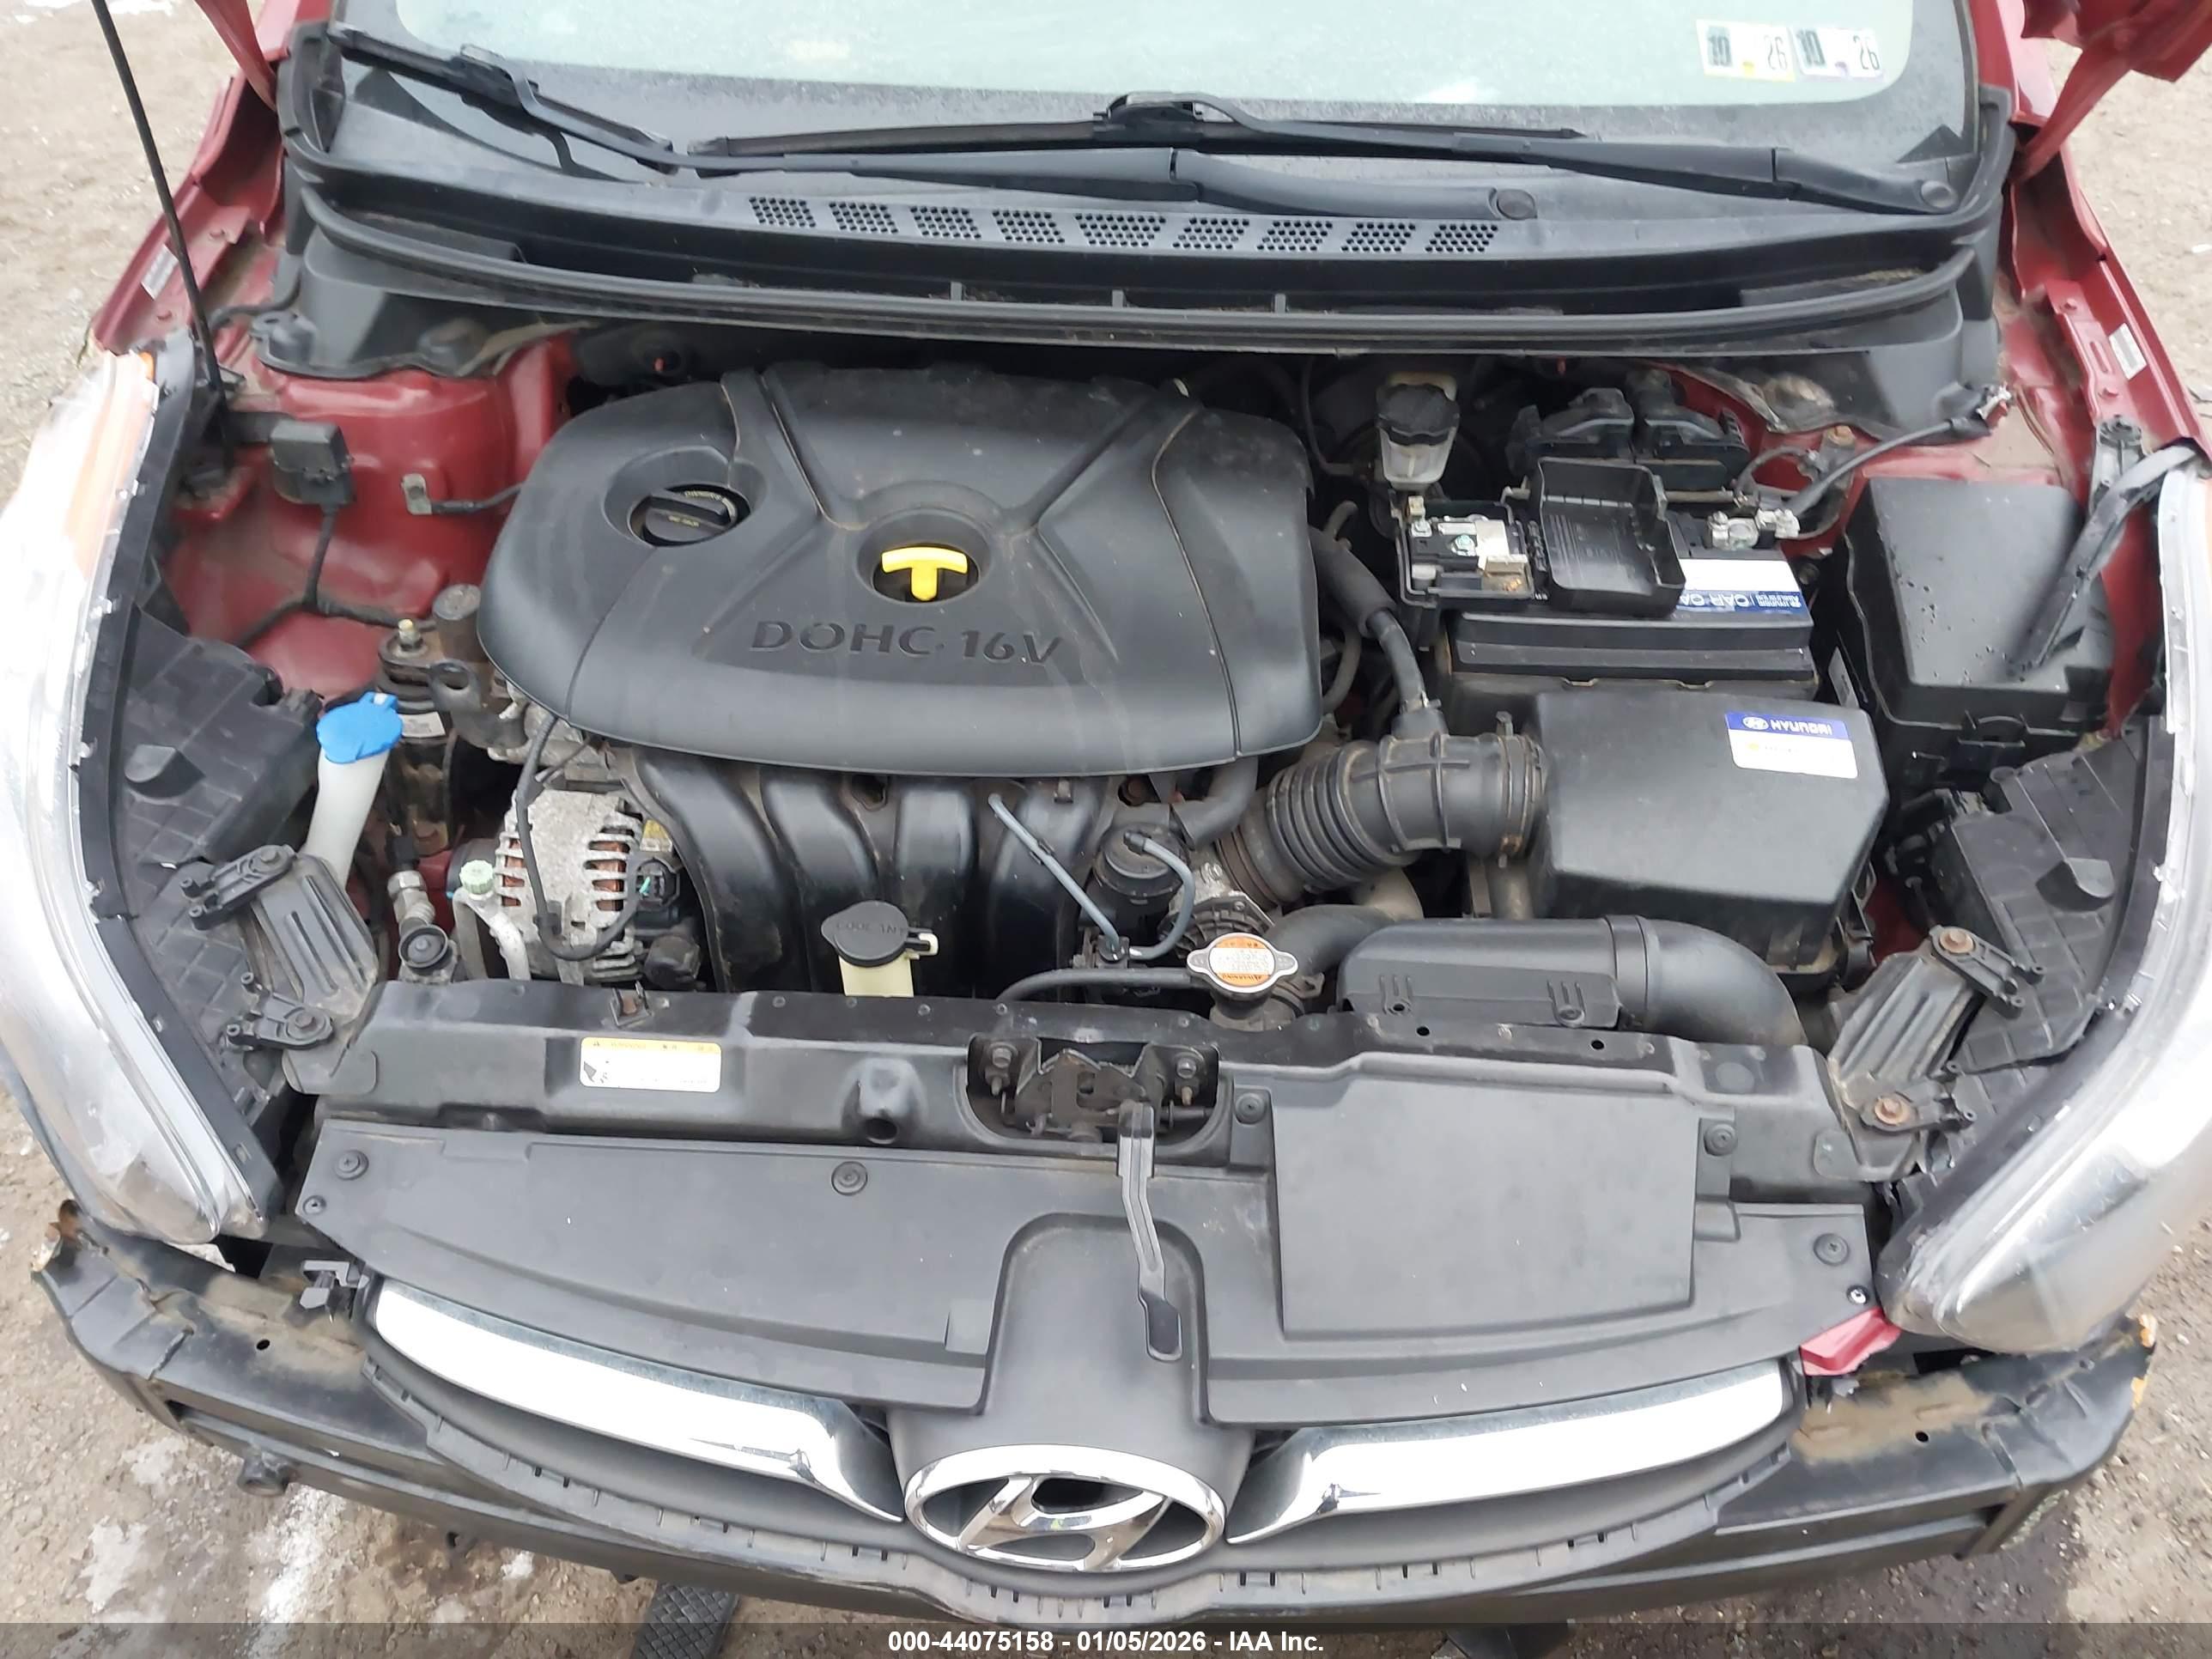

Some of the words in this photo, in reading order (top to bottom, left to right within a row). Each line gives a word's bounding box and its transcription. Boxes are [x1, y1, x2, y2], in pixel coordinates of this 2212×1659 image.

[1763, 35, 1789, 70] 26
[1852, 35, 1881, 70] 26
[1680, 593, 1705, 606] CA
[751, 620, 937, 658] DOHC
[962, 628, 1065, 665] 16V
[1770, 719, 1833, 736] HYUNDAI
